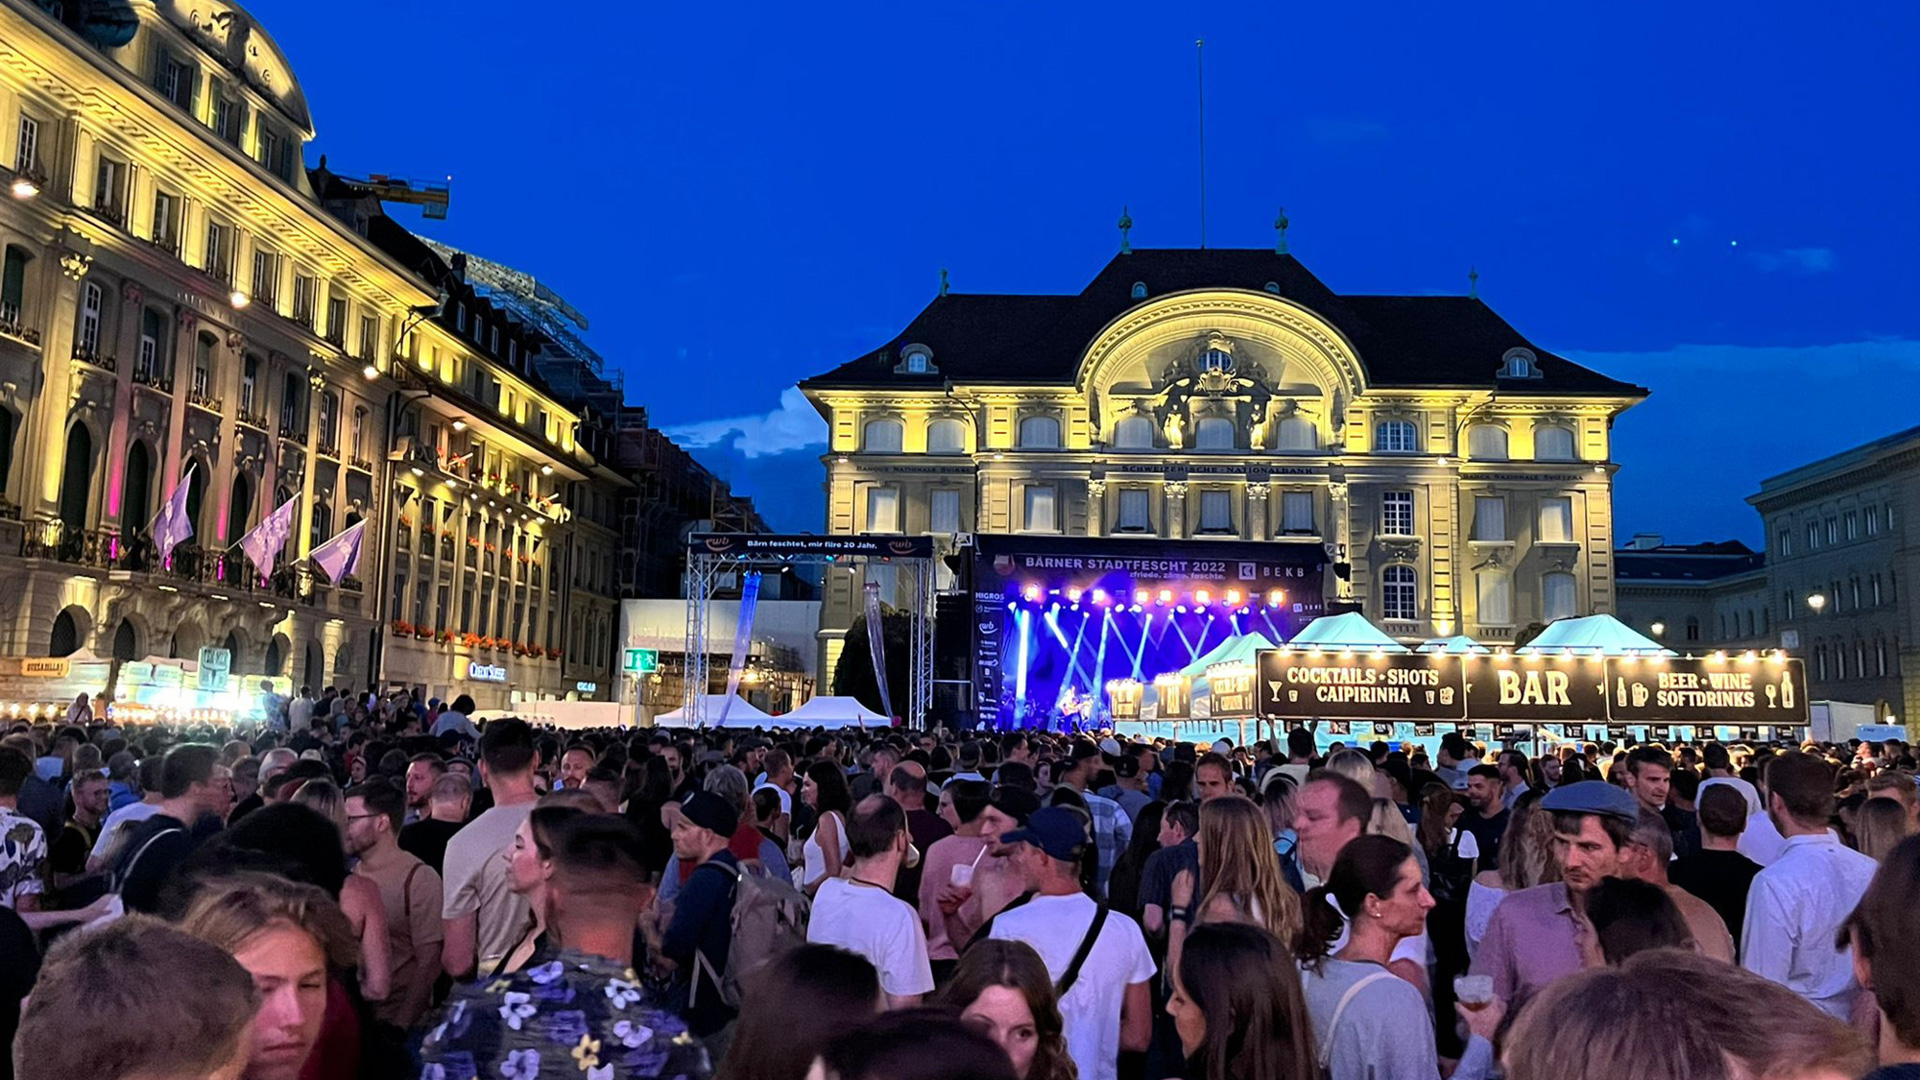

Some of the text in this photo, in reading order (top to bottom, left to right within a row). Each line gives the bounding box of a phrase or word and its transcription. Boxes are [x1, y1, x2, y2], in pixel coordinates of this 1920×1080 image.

[856, 541, 878, 549] Jahr.
[1087, 559, 1188, 571] STADTFESCHT
[1192, 561, 1226, 572] 2022
[1287, 667, 1439, 686] COCKTAILS SHOTS
[1657, 673, 1753, 690] BEER WINE
[1316, 686, 1411, 704] CAIPIRINHA
[1497, 669, 1572, 705] BAR
[1656, 691, 1756, 708] SOFTDRINKS
